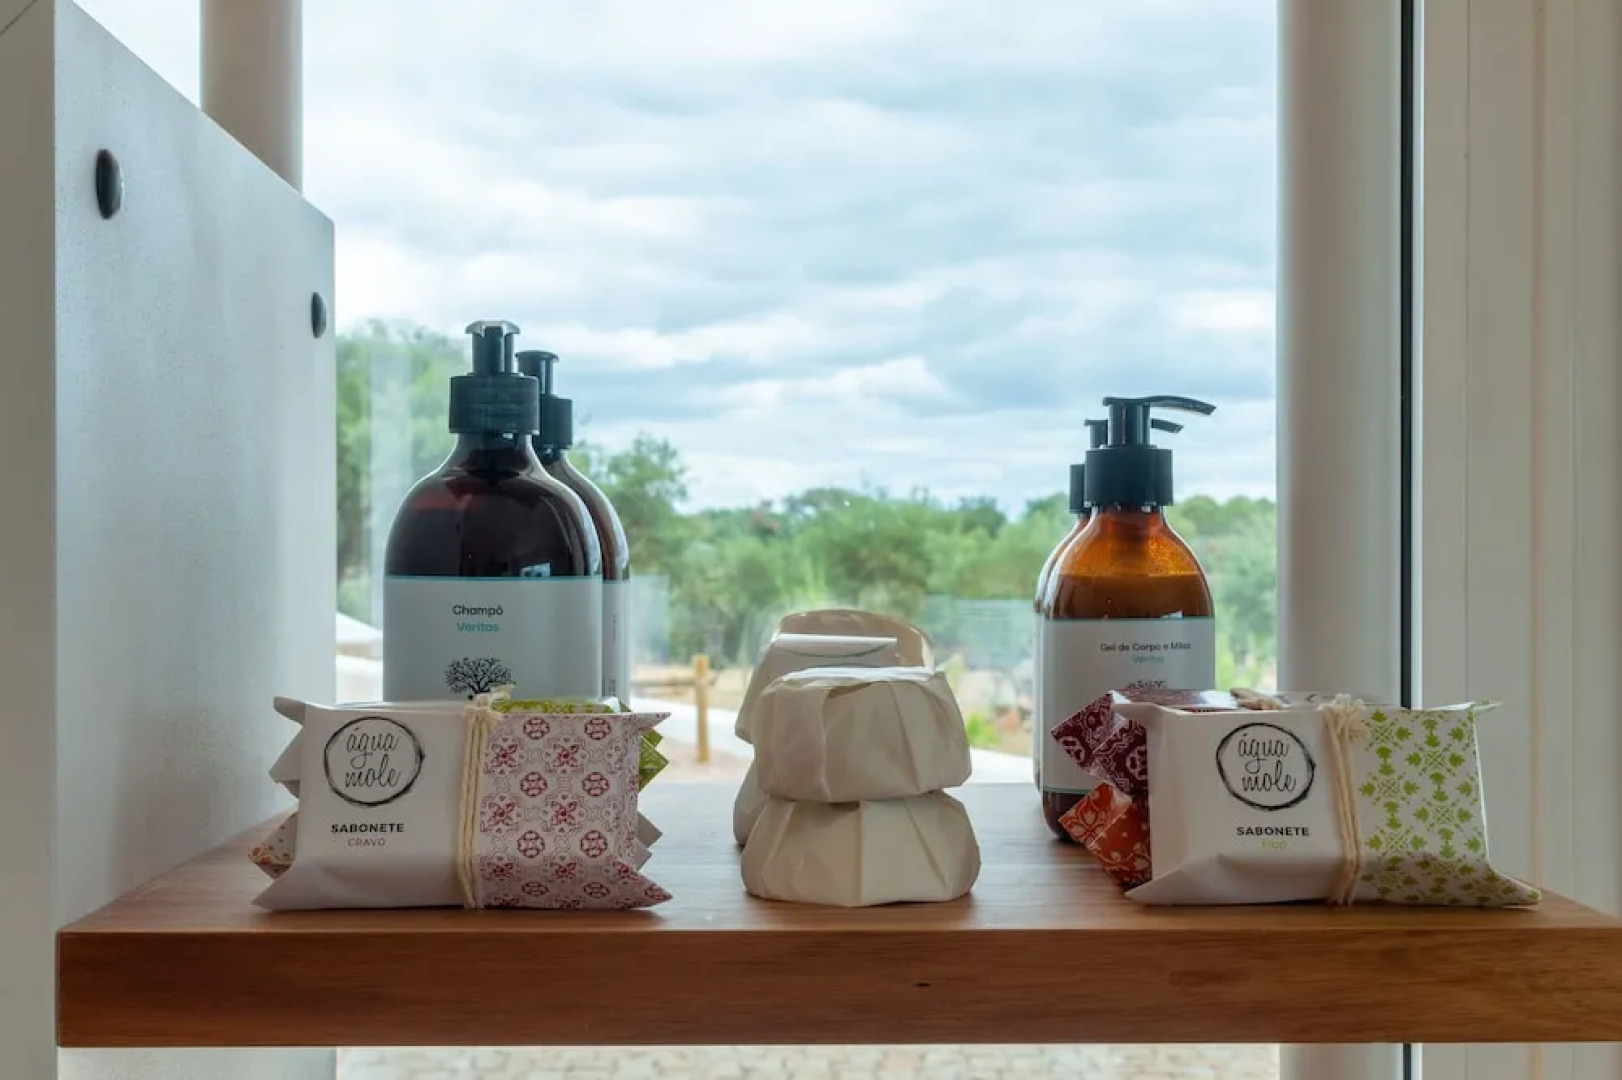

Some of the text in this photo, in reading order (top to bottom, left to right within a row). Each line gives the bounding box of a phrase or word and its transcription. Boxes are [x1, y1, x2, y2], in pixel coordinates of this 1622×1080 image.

[457, 622, 499, 632] Veritas
[1100, 643, 1116, 651] Gel
[1118, 642, 1130, 651] de
[1132, 643, 1161, 652] Corpo
[345, 754, 400, 788] mole
[1241, 761, 1297, 792] mole
[331, 823, 404, 833] SABONETE
[1236, 826, 1309, 836] SABONETE
[348, 838, 386, 846] CRAVO
